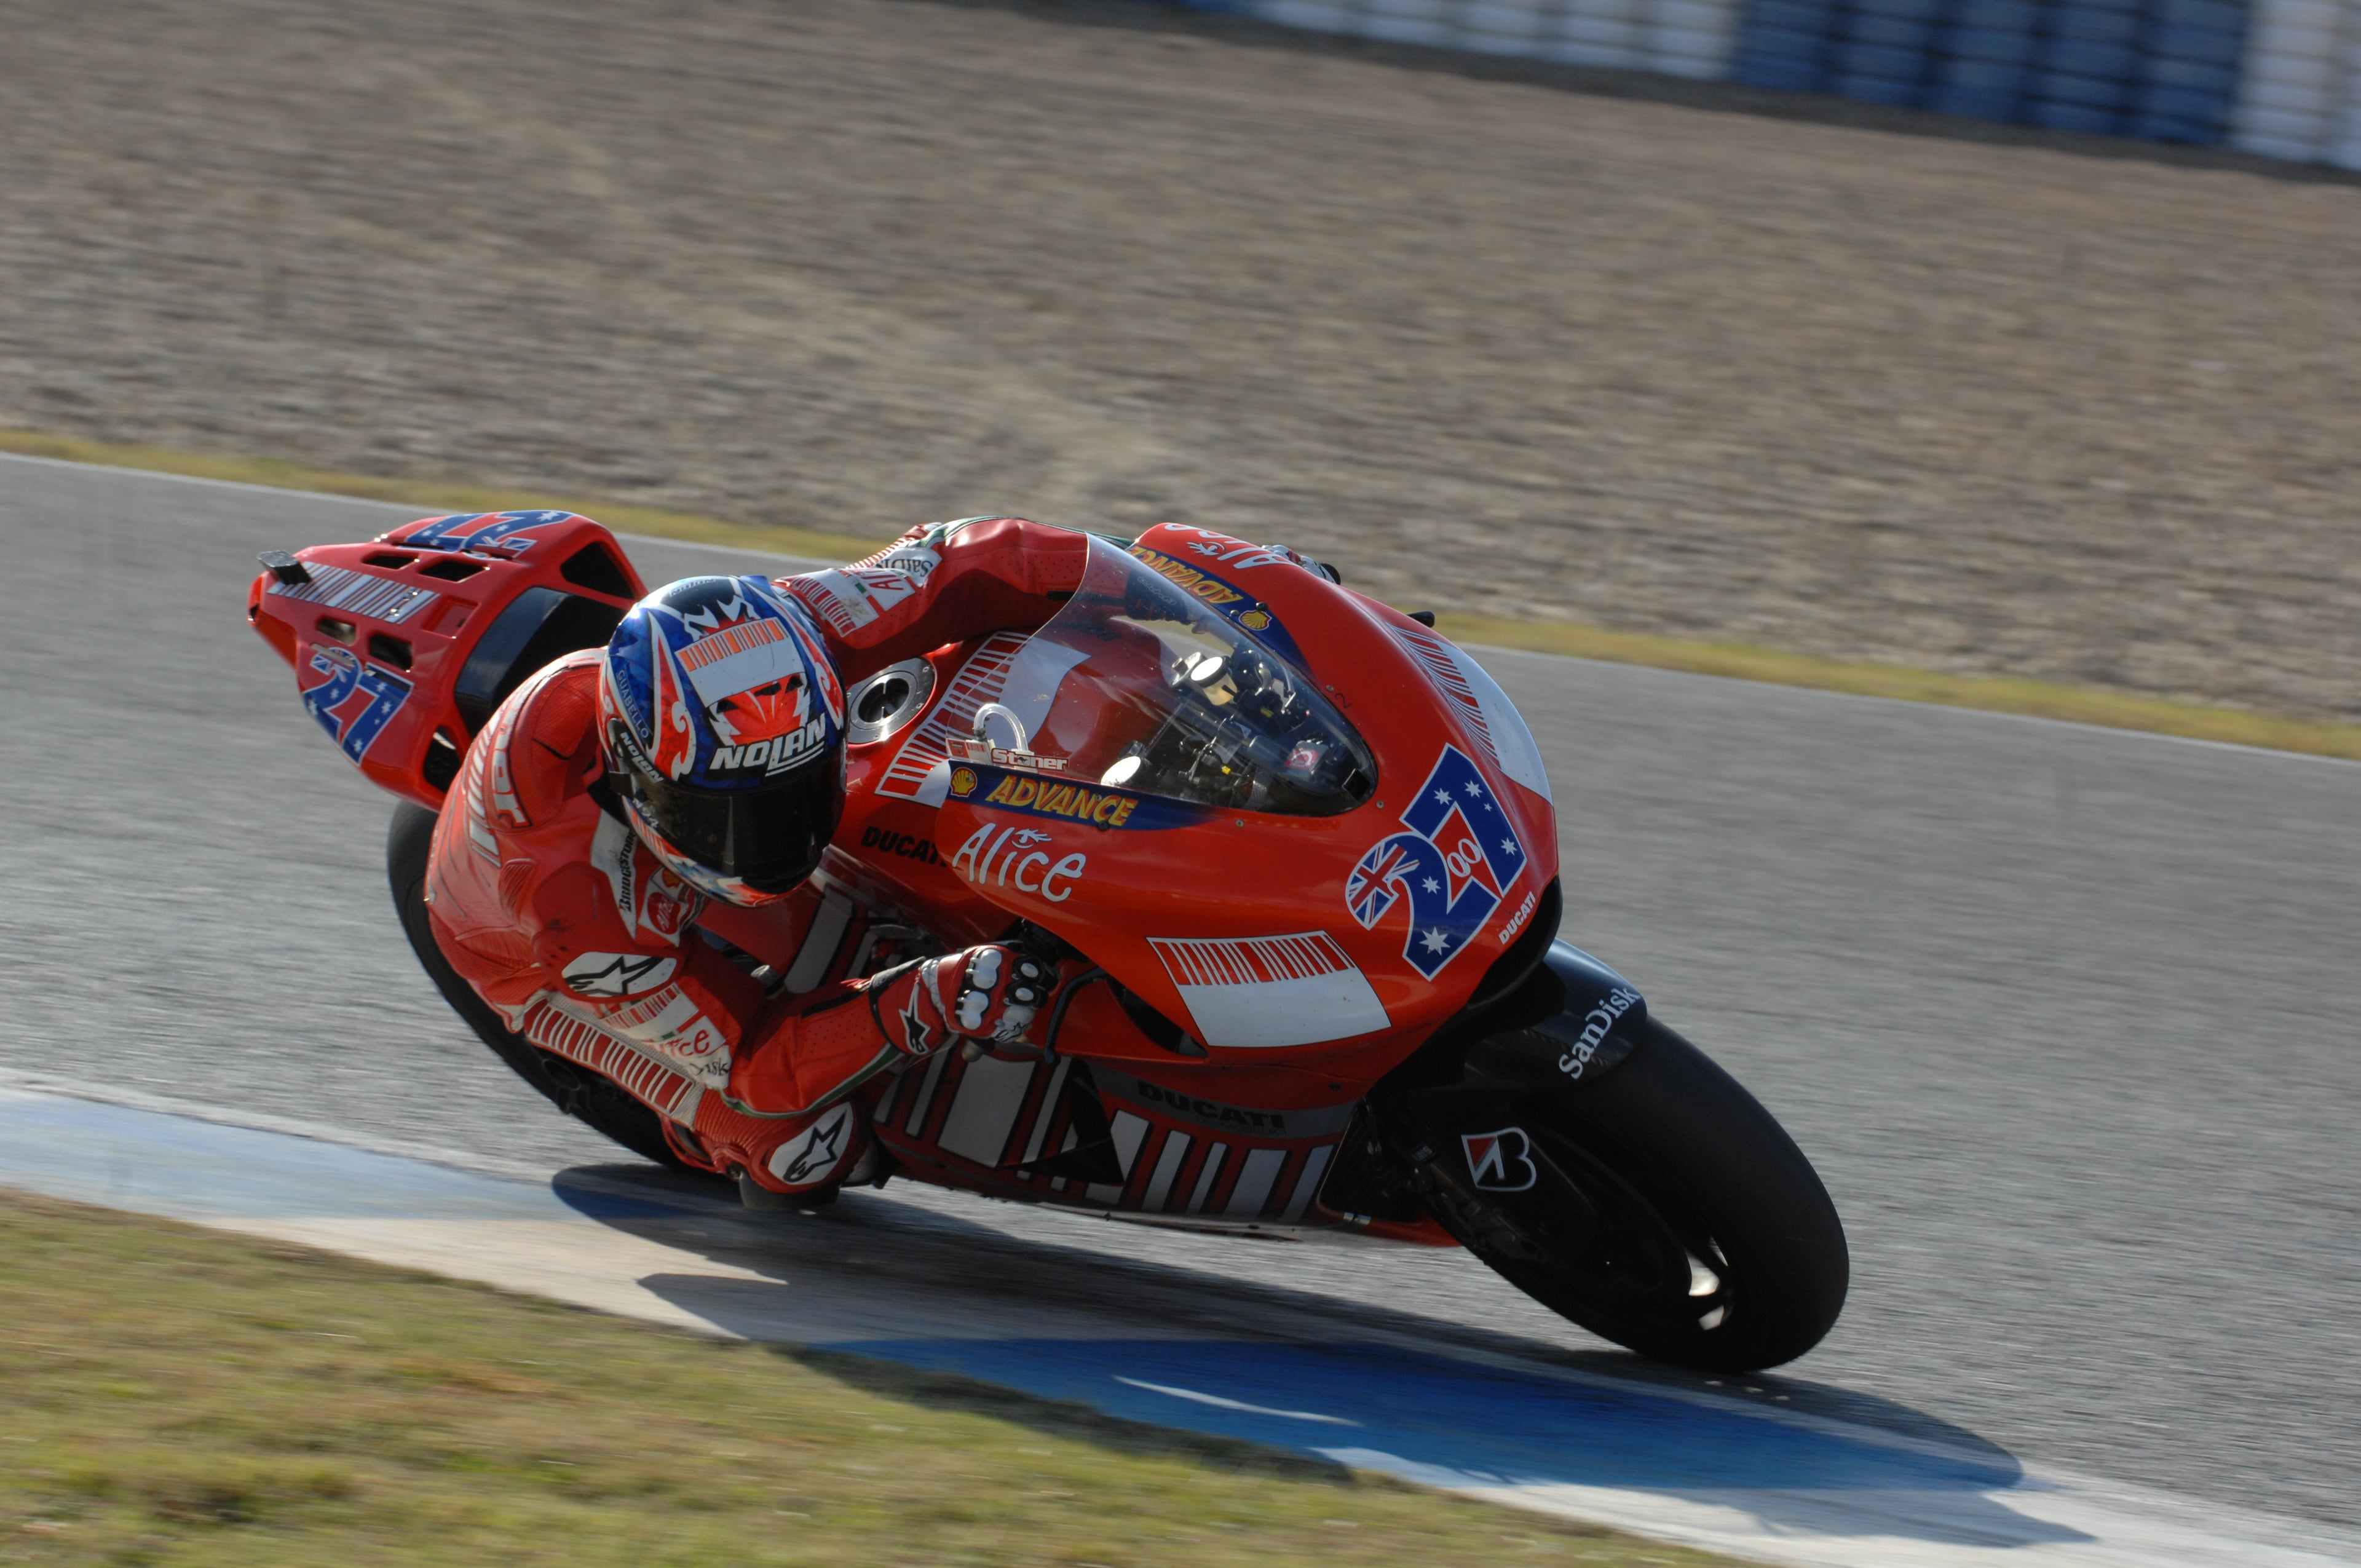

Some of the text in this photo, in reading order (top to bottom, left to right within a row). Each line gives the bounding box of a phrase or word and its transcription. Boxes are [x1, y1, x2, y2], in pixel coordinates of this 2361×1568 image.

[617, 669, 649, 739] GUABELLO
[710, 713, 826, 777] NOLAN
[992, 749, 1068, 770] Stoner
[986, 775, 1137, 826] ADVANCE
[861, 826, 947, 867] DUCAT
[952, 823, 1086, 902] Alice
[1345, 742, 1527, 982] 27
[1499, 891, 1536, 944] DUCATI
[1559, 987, 1641, 1080] SanDisk
[1137, 1080, 1284, 1128] DUCATI
